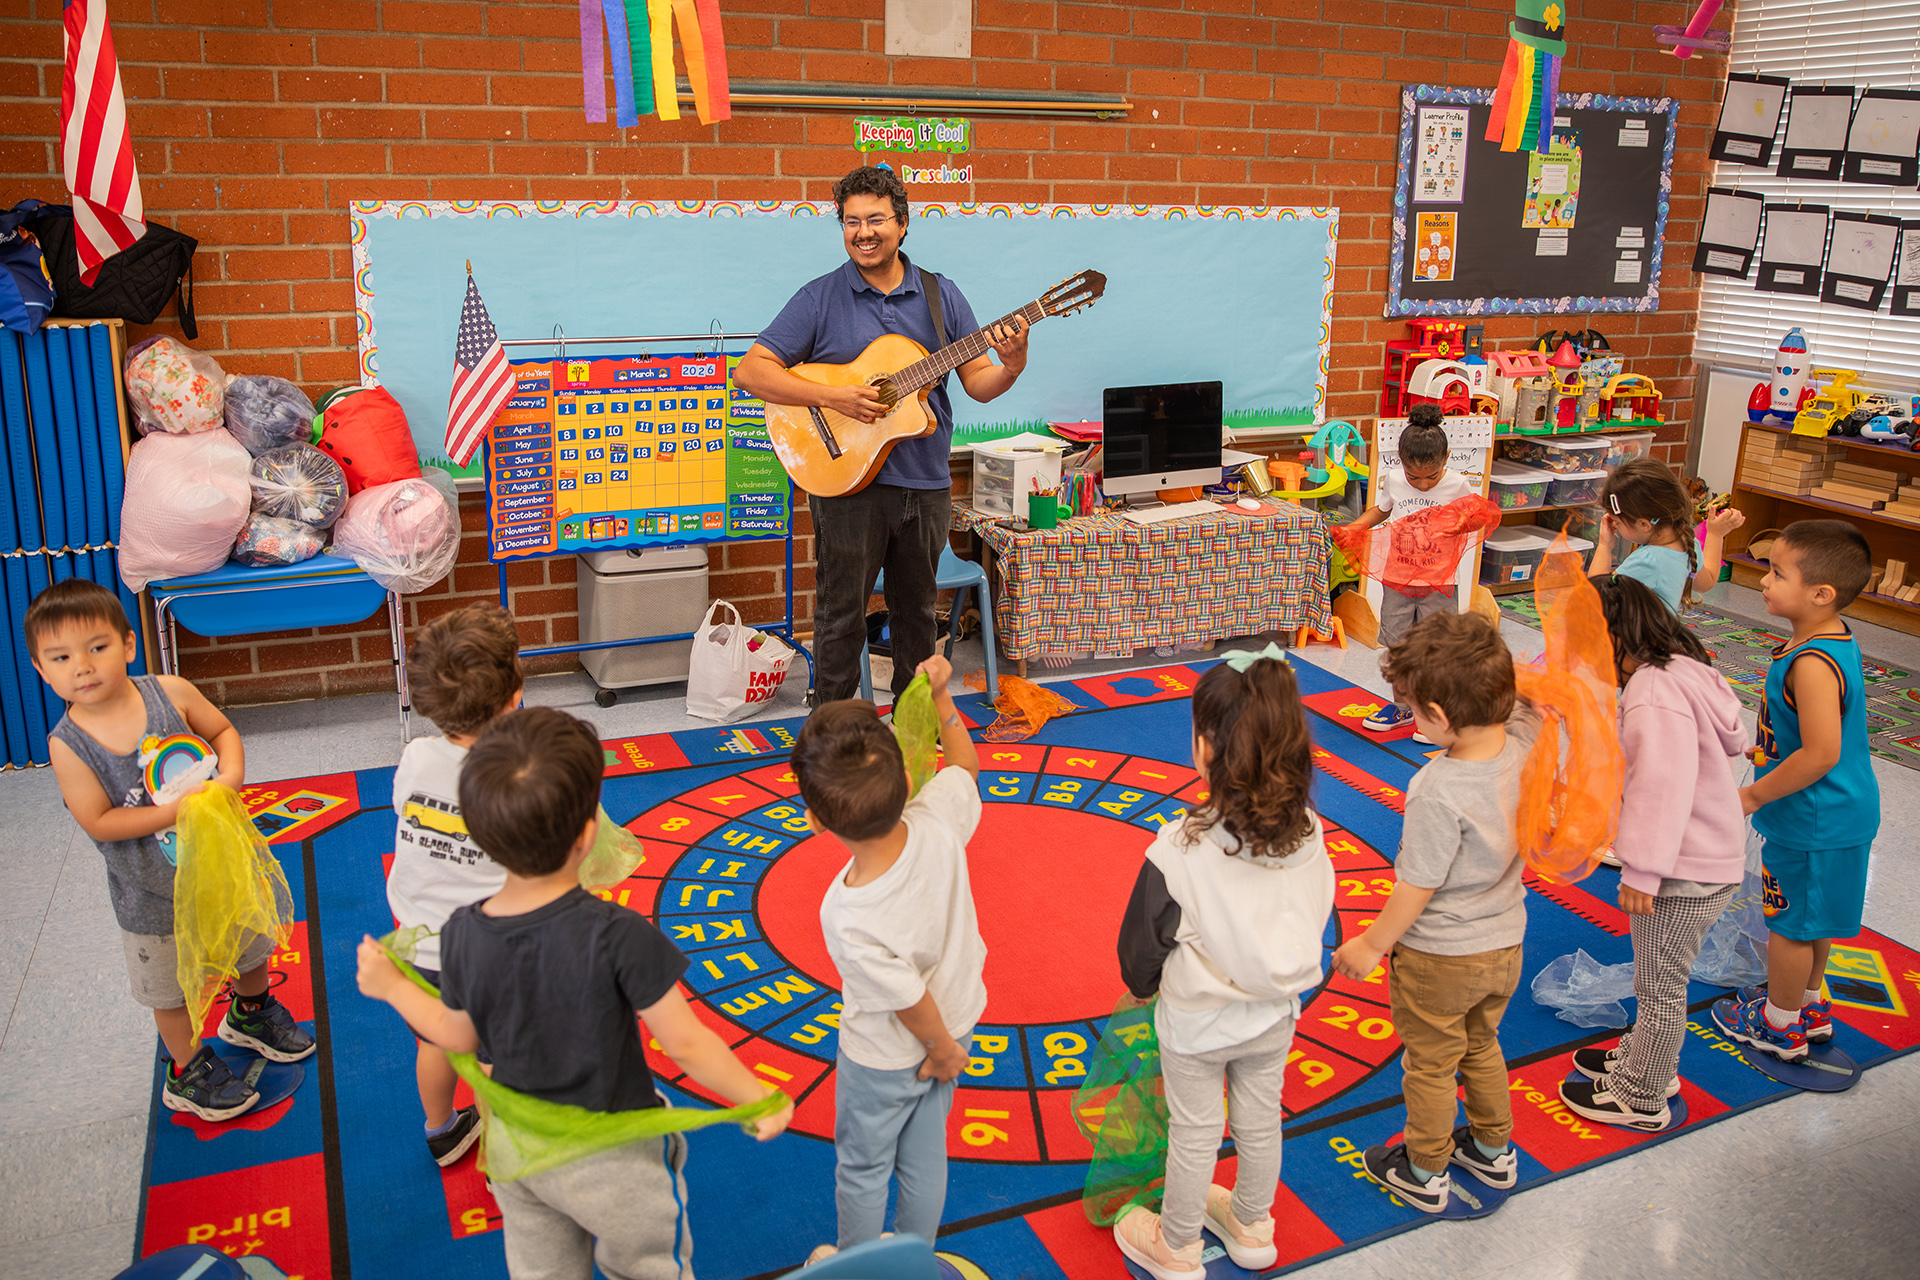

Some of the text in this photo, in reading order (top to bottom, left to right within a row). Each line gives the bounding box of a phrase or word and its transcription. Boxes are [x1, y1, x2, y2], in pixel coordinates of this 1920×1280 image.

[1424, 112, 1464, 121] Learner Profile
[860, 123, 964, 148] Keeping It Cool
[902, 164, 972, 184] Preschool
[526, 370, 535, 378] the
[534, 369, 551, 377] Year
[630, 369, 655, 378] March
[683, 364, 714, 376] 2026
[518, 382, 537, 390] uary
[564, 404, 570, 414] 1
[592, 404, 598, 414] 2
[616, 403, 623, 412] 3
[640, 401, 647, 410] 4
[664, 401, 671, 410] 5
[686, 400, 693, 409] 6
[712, 400, 718, 408] 7
[510, 411, 535, 420] March
[739, 408, 765, 416] Wednes
[640, 422, 649, 432] 11
[661, 424, 672, 434] 12
[685, 424, 696, 433] 13
[708, 420, 720, 428] 14
[512, 425, 532, 435] April
[563, 430, 570, 440] 8
[588, 429, 595, 439] 9
[608, 426, 620, 436] 10
[728, 430, 748, 438] Days
[515, 441, 532, 450] May
[662, 443, 673, 452] 19
[686, 440, 699, 450] 20
[709, 441, 720, 451] 21
[746, 440, 773, 450] Sunday
[564, 450, 576, 459] 15
[590, 450, 601, 459] 16
[614, 453, 625, 462] 17
[637, 448, 648, 457] 18
[514, 456, 534, 464] June
[743, 455, 773, 463] Monday
[516, 468, 532, 478] July
[613, 471, 626, 480] 24
[743, 468, 772, 476] Tuesday
[587, 474, 600, 483] 23
[511, 482, 540, 493] August
[560, 480, 574, 489] 22
[736, 481, 778, 489] Wednesday
[504, 496, 546, 508] September
[740, 494, 774, 503] Thursday
[1398, 498, 1442, 511] SOMEONE'S
[509, 510, 542, 520] October
[746, 508, 768, 516] Friday
[505, 524, 541, 536] November
[741, 521, 775, 529] Saturday
[505, 536, 542, 549] December
[1397, 556, 1418, 567] FERAL
[1422, 558, 1436, 566] KID
[1158, 674, 1189, 692] blue
[769, 727, 797, 748] boat
[622, 742, 655, 769] green
[992, 753, 1022, 762] 3
[1066, 757, 1097, 768] 2
[1139, 770, 1168, 780] 1
[988, 776, 1020, 797] Cc
[1042, 780, 1082, 804] Bb
[709, 794, 747, 805] 7
[1098, 790, 1144, 815] Aa
[660, 817, 690, 831] 8
[762, 806, 812, 832] Gg
[722, 830, 782, 854] Hh
[697, 858, 746, 878] Ii
[1339, 878, 1394, 896] 23
[1762, 875, 1779, 892] NE
[679, 885, 735, 907] Jj
[671, 919, 747, 942] Kk
[720, 975, 816, 1015] Mm
[1319, 1006, 1394, 1040] 20
[964, 1034, 1008, 1077] Pp
[1043, 1032, 1088, 1084] Qq
[1286, 1050, 1335, 1088] 19
[1508, 1078, 1602, 1140] yellow
[961, 1108, 1010, 1146] 16
[188, 1206, 291, 1244] bird
[461, 1208, 488, 1234] 5
